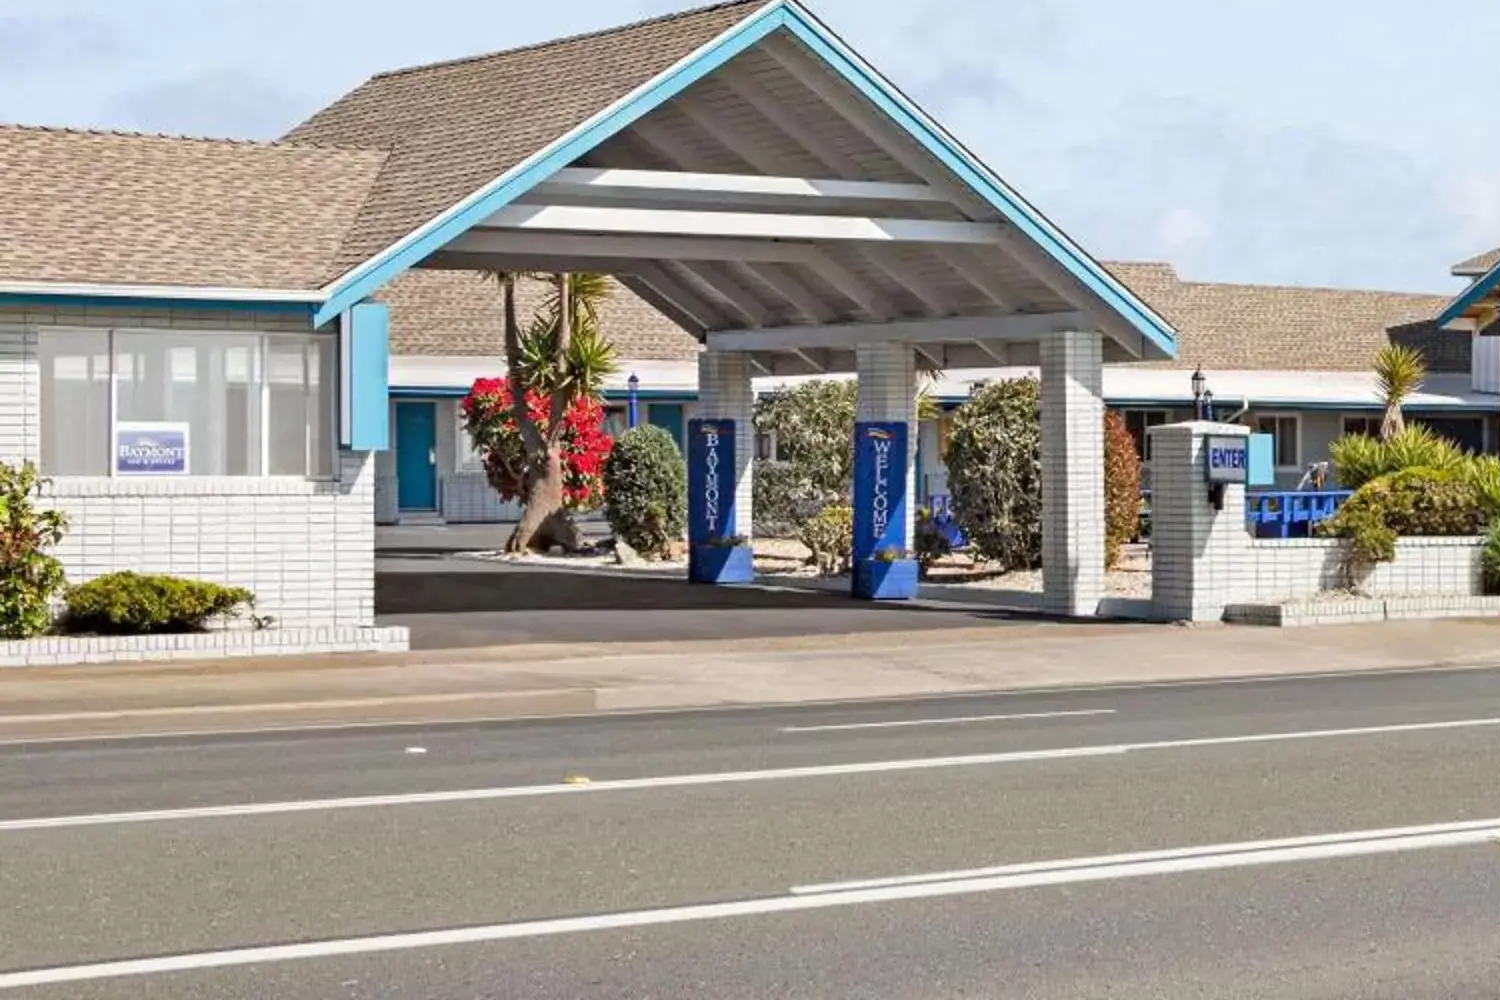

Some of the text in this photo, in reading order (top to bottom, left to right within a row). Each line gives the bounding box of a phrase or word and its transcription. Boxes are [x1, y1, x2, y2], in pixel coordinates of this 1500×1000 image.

[705, 433, 719, 530] BAYMONT
[873, 440, 890, 538] WELCOME
[1212, 447, 1246, 468] ENTER
